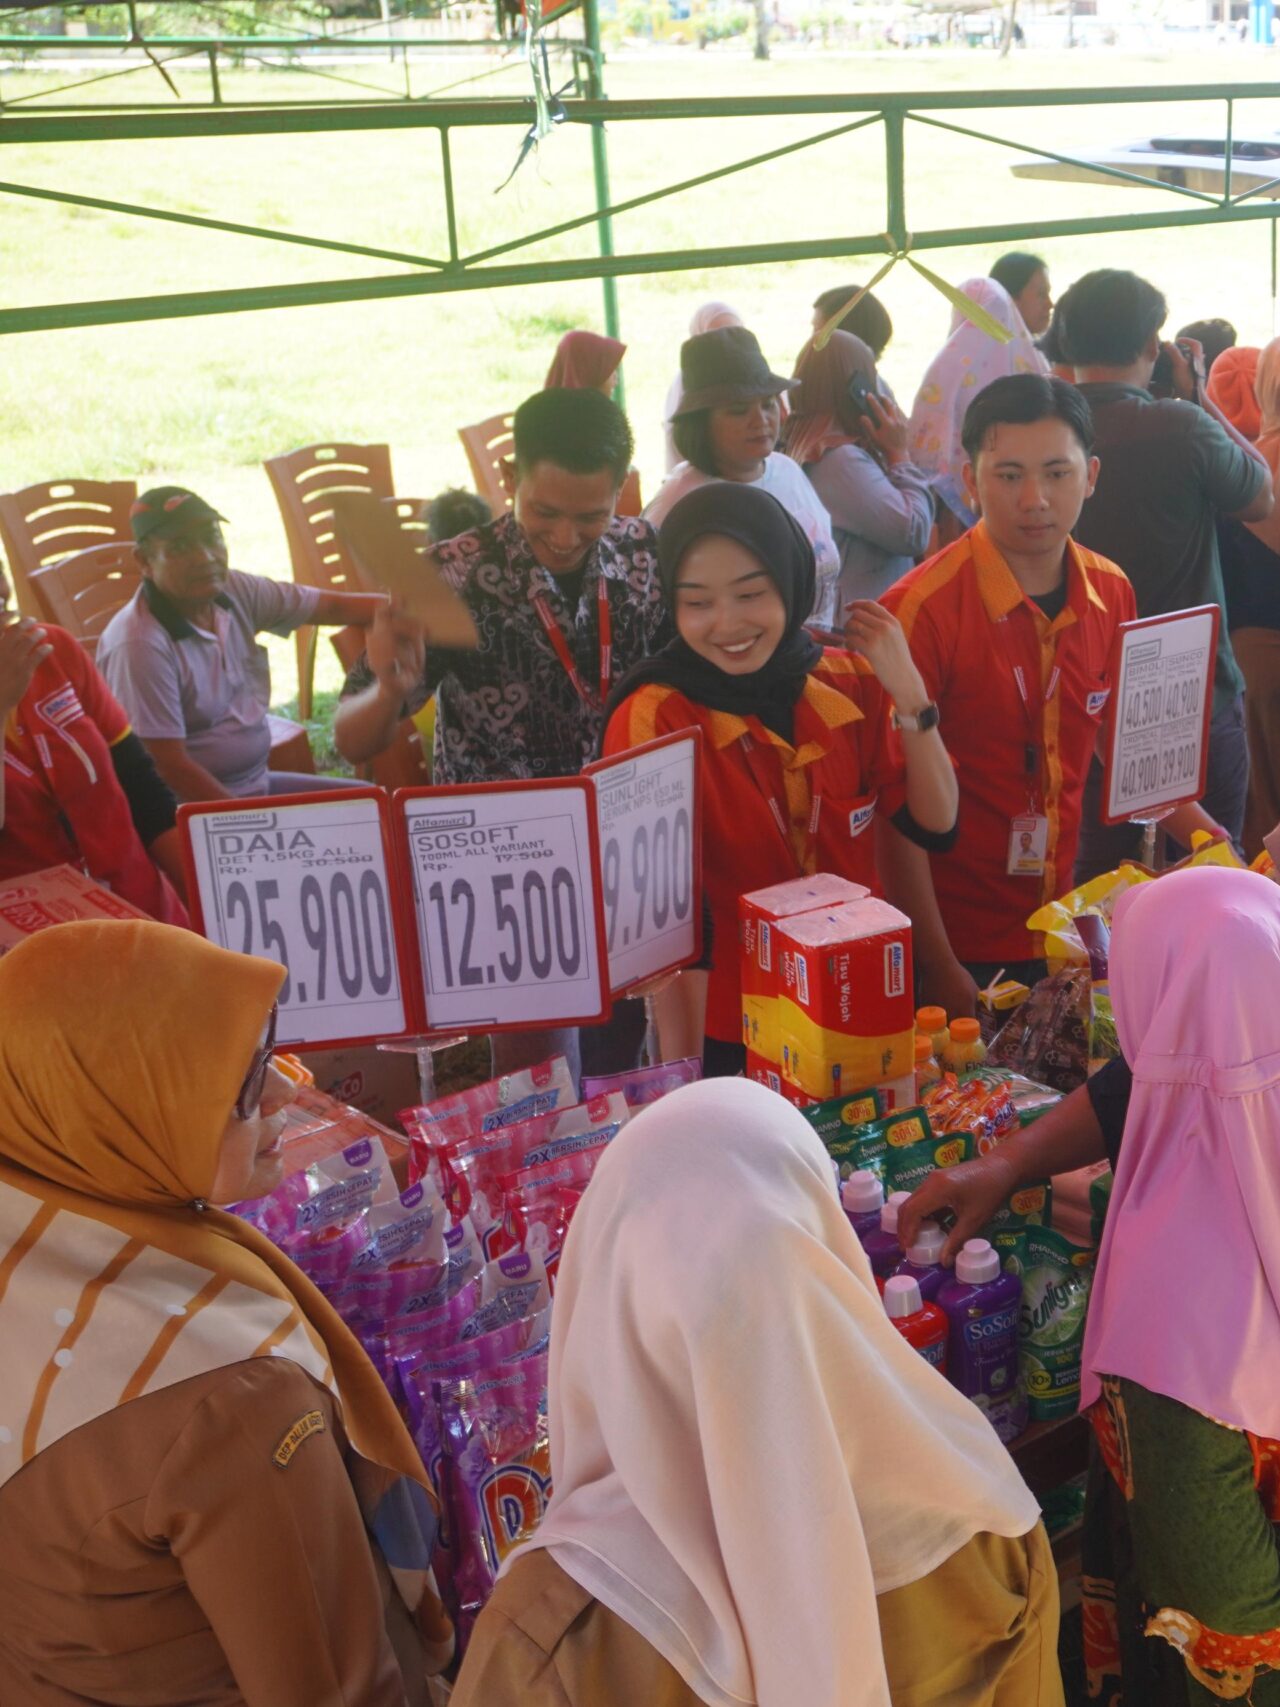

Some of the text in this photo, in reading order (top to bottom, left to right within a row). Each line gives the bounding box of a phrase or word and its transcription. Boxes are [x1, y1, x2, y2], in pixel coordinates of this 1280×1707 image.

[1168, 651, 1203, 666] SUNCO
[1128, 661, 1164, 677] BIMOLI
[1126, 686, 1162, 729] 40.500
[1166, 677, 1200, 720] 40.900
[1161, 742, 1196, 786] 39.900
[1121, 753, 1158, 797] 40.900
[602, 772, 662, 809] SUNLIGHT
[413, 815, 467, 829] Alfamart
[218, 830, 315, 855] DAIA
[417, 825, 518, 852] SOSOFT
[218, 855, 253, 867] DET
[322, 847, 360, 858] ALL
[420, 839, 546, 861] 700ML ALL VARIANT
[220, 866, 253, 875] Rp.
[423, 862, 453, 872] Rp.
[603, 808, 690, 953] 9.900
[226, 869, 392, 1005] 25.900
[429, 866, 581, 988] 12.500
[892, 944, 902, 993] Alfamart
[839, 953, 852, 1023] Tisu Wajah
[487, 1114, 505, 1131] 2X
[846, 1106, 871, 1122] 30%
[814, 1118, 842, 1135] HAMNO
[893, 1125, 918, 1142] 30%
[349, 1152, 370, 1164] BARU
[530, 1151, 550, 1166] 2X
[894, 1163, 937, 1183] RHAMNO
[1016, 1193, 1043, 1212] 30%
[302, 1205, 319, 1224] 2X
[357, 1249, 377, 1267] 2X
[504, 1263, 527, 1275] BARU
[1018, 1272, 1088, 1339] Sunlight
[970, 1311, 1018, 1341] SoSoft
